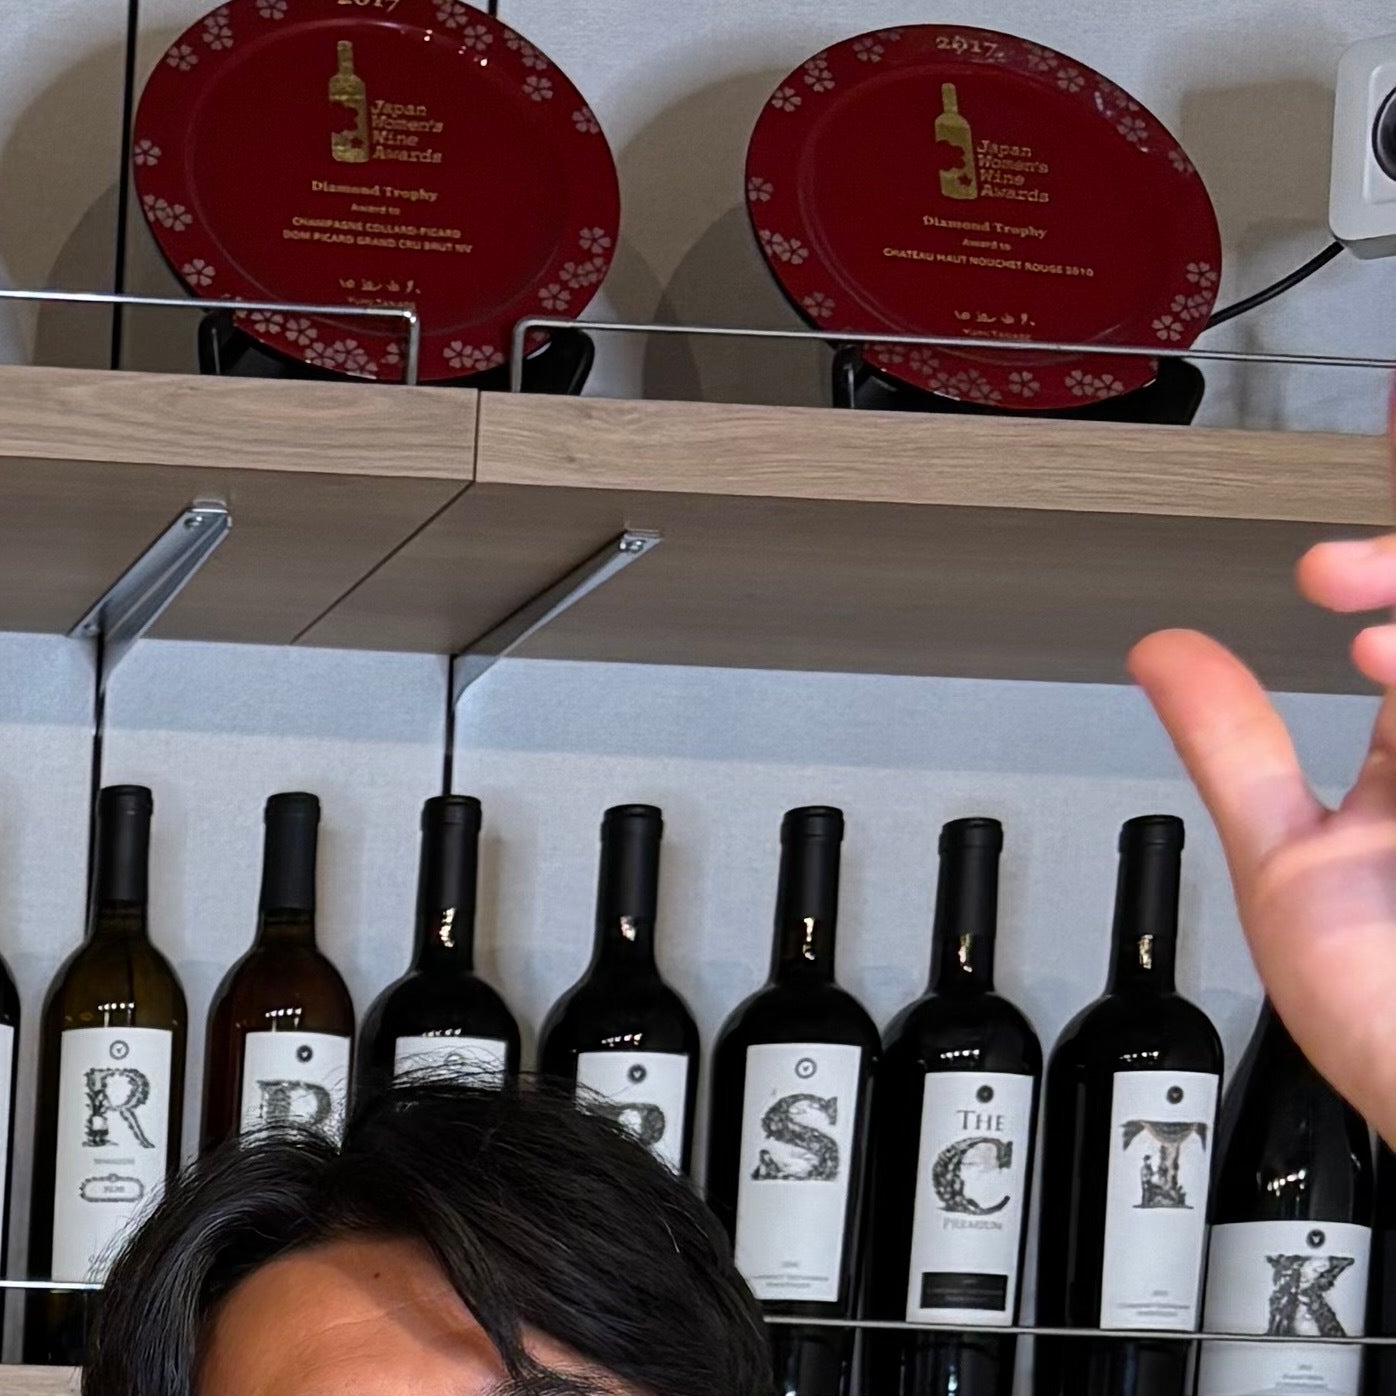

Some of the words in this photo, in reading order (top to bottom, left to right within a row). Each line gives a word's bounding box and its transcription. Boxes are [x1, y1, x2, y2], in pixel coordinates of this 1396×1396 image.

[936, 35, 998, 57] 2017
[370, 100, 427, 117] Japan
[372, 130, 419, 146] Wine
[373, 146, 443, 163] Awards
[977, 140, 1032, 158] Japan
[977, 154, 1049, 174] Women's
[979, 169, 1025, 186] Wine
[311, 180, 380, 197] Diamond
[383, 186, 438, 202] Trophy
[980, 184, 1049, 203] Awards
[922, 215, 990, 232] Diamond
[993, 222, 1048, 239] Trophy
[883, 247, 934, 261] CHATEAU
[81, 1067, 156, 1149] R
[956, 1110, 1004, 1131] THE
[751, 1093, 840, 1182] S
[1120, 1120, 1208, 1209] T
[932, 1137, 1013, 1215] C
[1265, 1253, 1354, 1338] K
